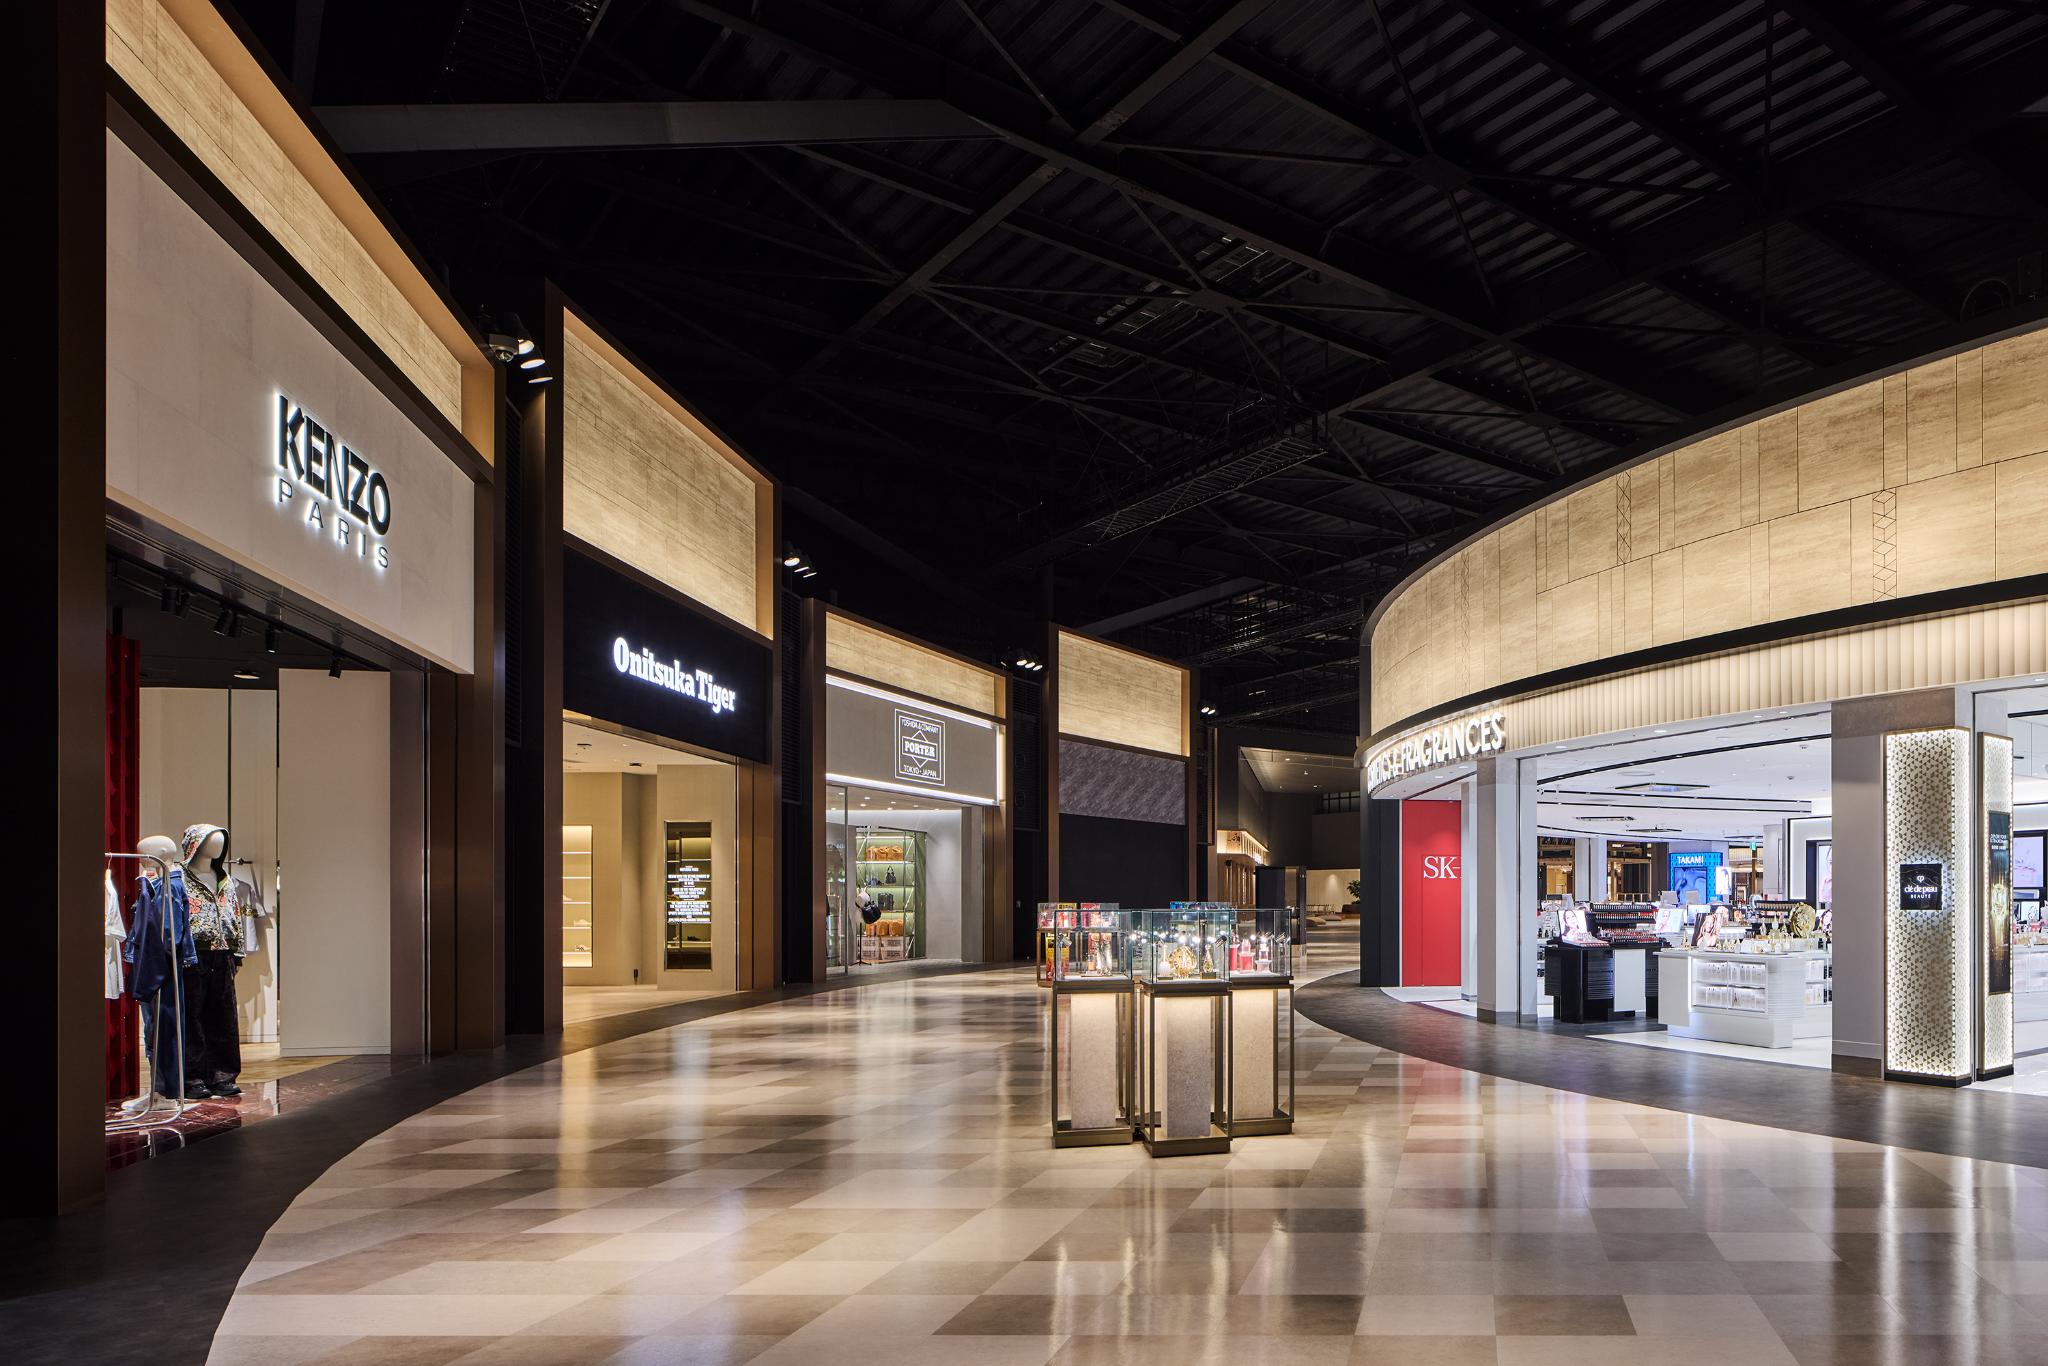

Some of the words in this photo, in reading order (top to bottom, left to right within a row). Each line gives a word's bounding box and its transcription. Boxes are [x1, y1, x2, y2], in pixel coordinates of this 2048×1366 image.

[277, 394, 391, 536] KENZO
[278, 477, 389, 569] PARIS
[613, 636, 695, 698] Onitsuka
[695, 668, 736, 714] Tiger
[904, 741, 936, 757] PORTER
[1401, 711, 1505, 773] FRAGRANCES
[903, 765, 919, 774] TOKYO
[922, 768, 937, 778] JAPAN
[1423, 855, 1462, 879] SK-
[1677, 855, 1704, 865] TAKAMI
[1913, 884, 1922, 893] de
[1922, 886, 1938, 895] peau
